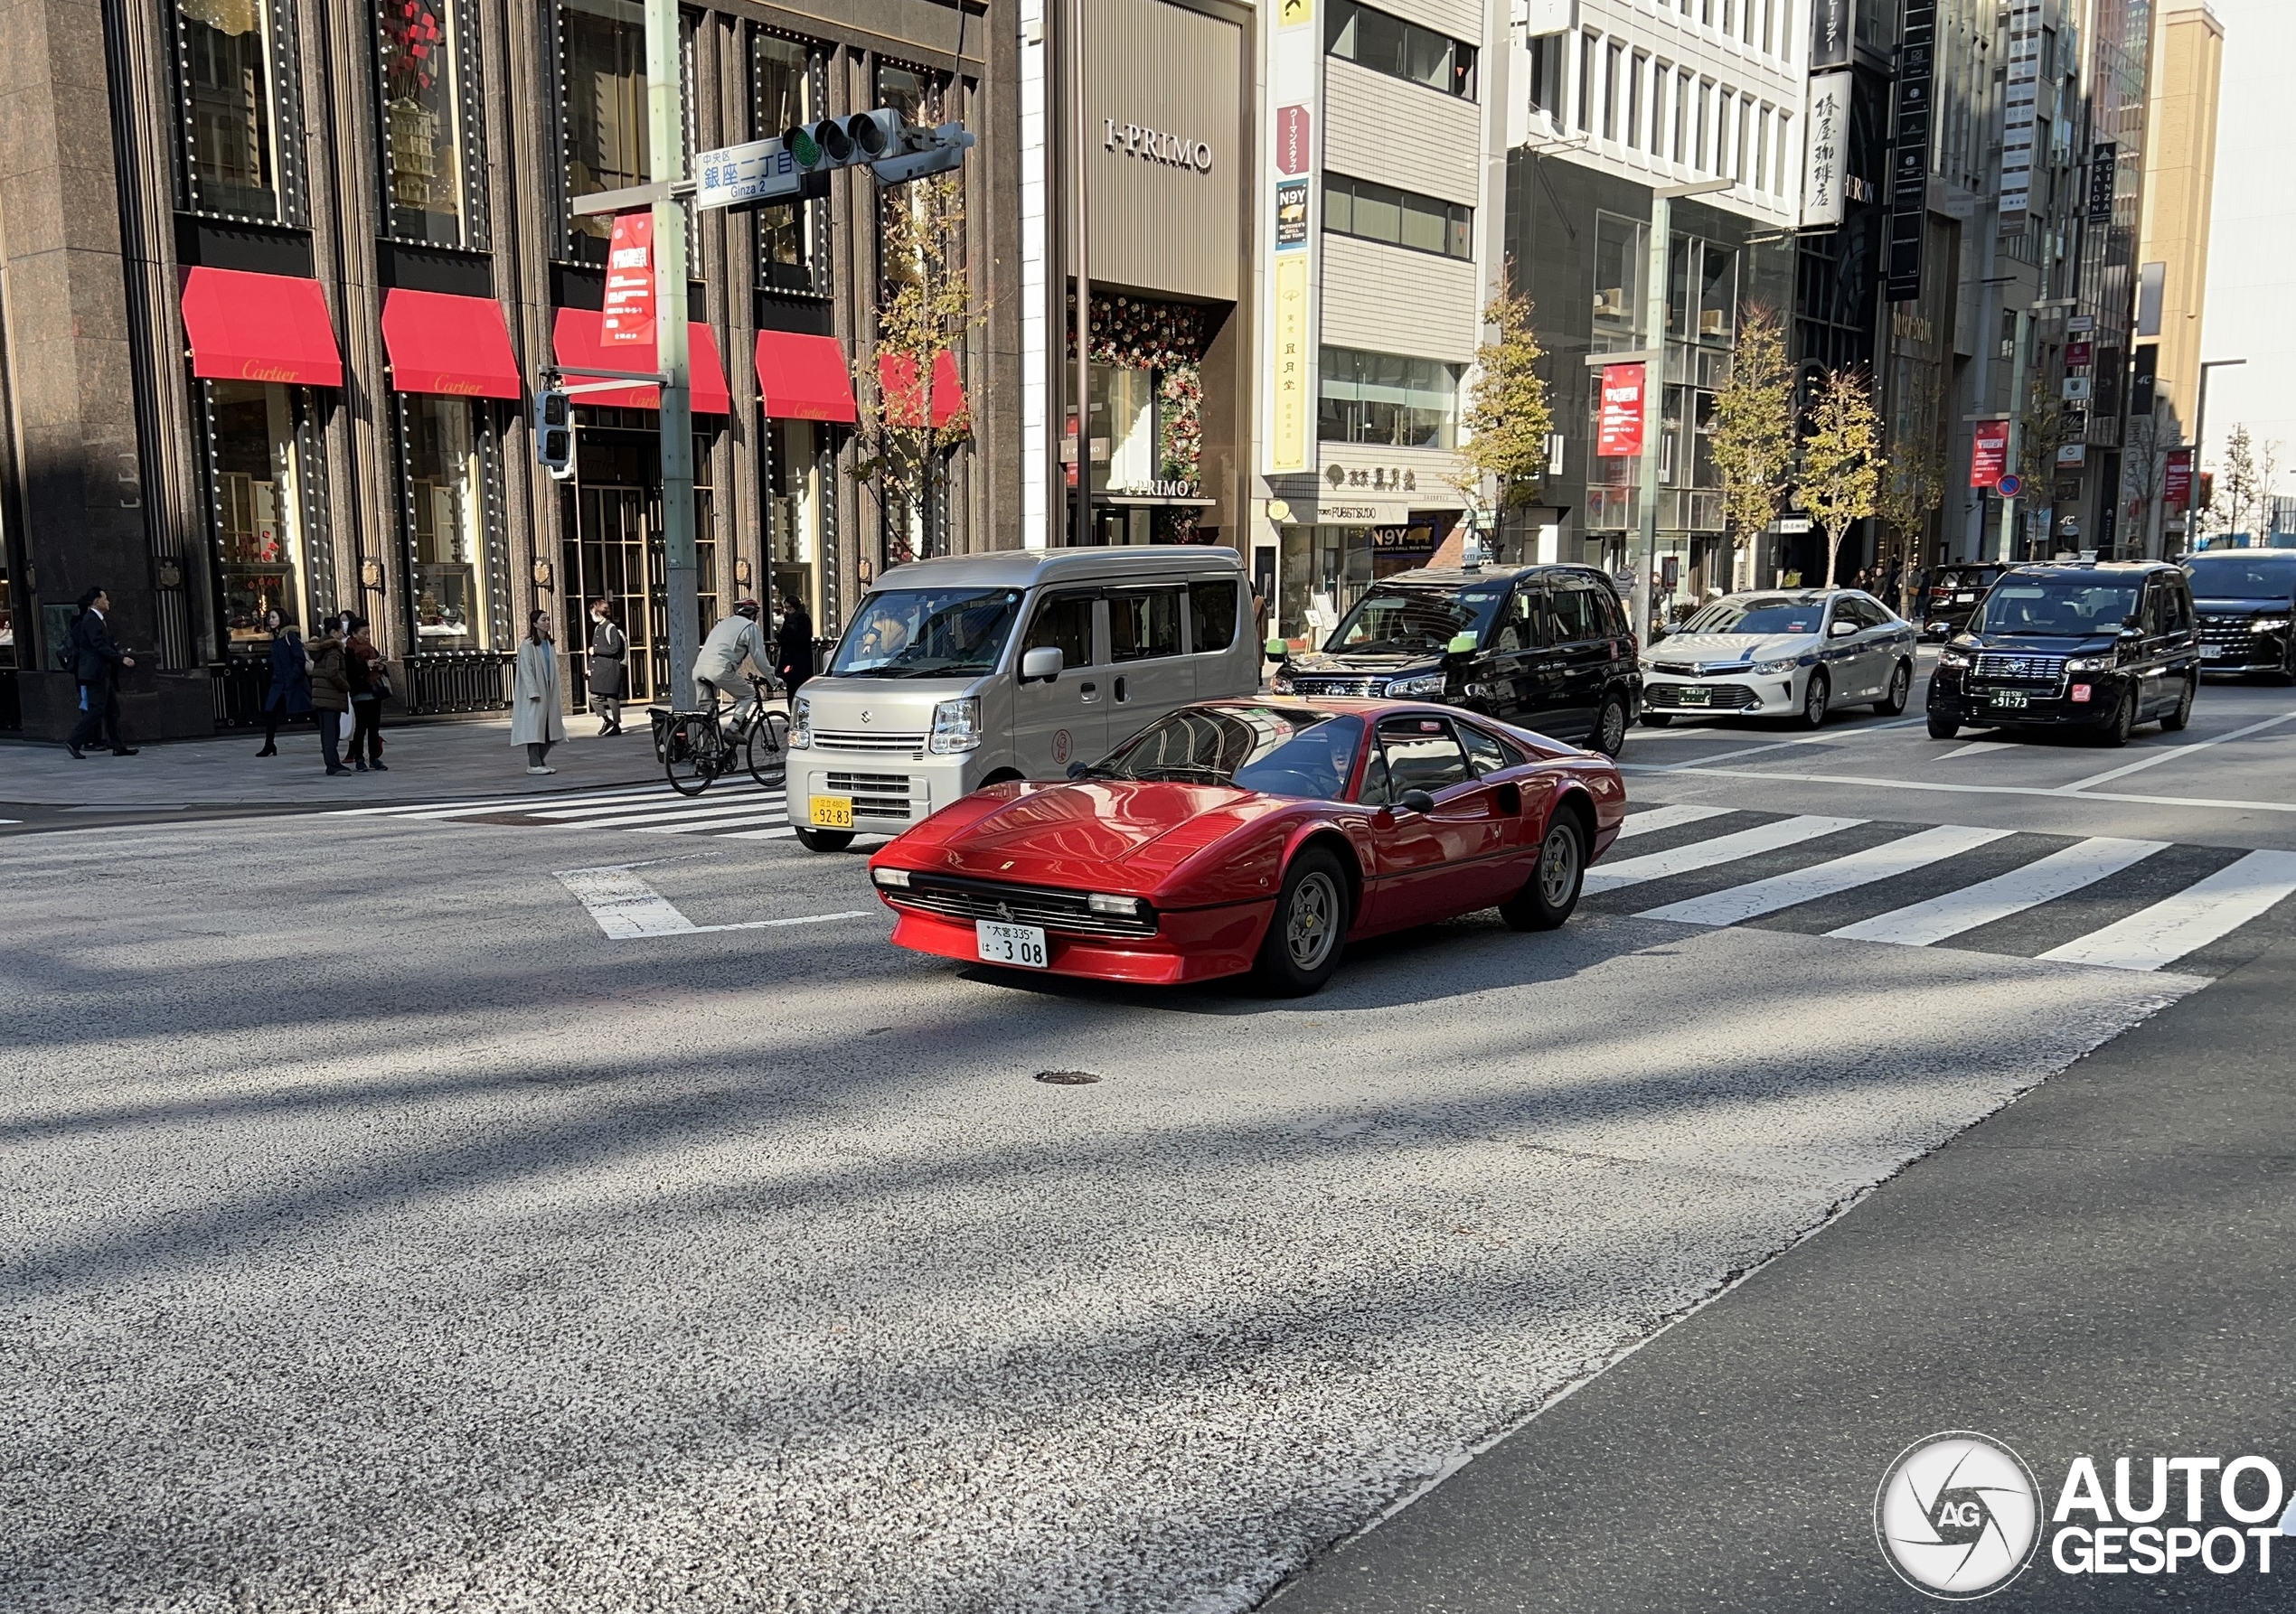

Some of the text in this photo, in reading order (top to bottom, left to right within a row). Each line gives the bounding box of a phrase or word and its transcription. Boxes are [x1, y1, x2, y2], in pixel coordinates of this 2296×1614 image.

[1104, 117, 1212, 170] I-PRIMO
[702, 150, 729, 164] 中央区
[703, 151, 793, 190] 銀座二丁目
[731, 183, 766, 198] Ginza 2
[2092, 164, 2102, 211] SALON
[2103, 164, 2113, 211] GINZA
[1279, 189, 1306, 205] N9Y
[242, 358, 299, 381] Cartier
[434, 372, 484, 395] Cartier
[795, 402, 828, 419] Cartier
[1372, 528, 1407, 546] N9Y
[1998, 696, 2028, 708] 91-73
[819, 809, 850, 824] 92-83
[992, 925, 1030, 941] 大宮 335
